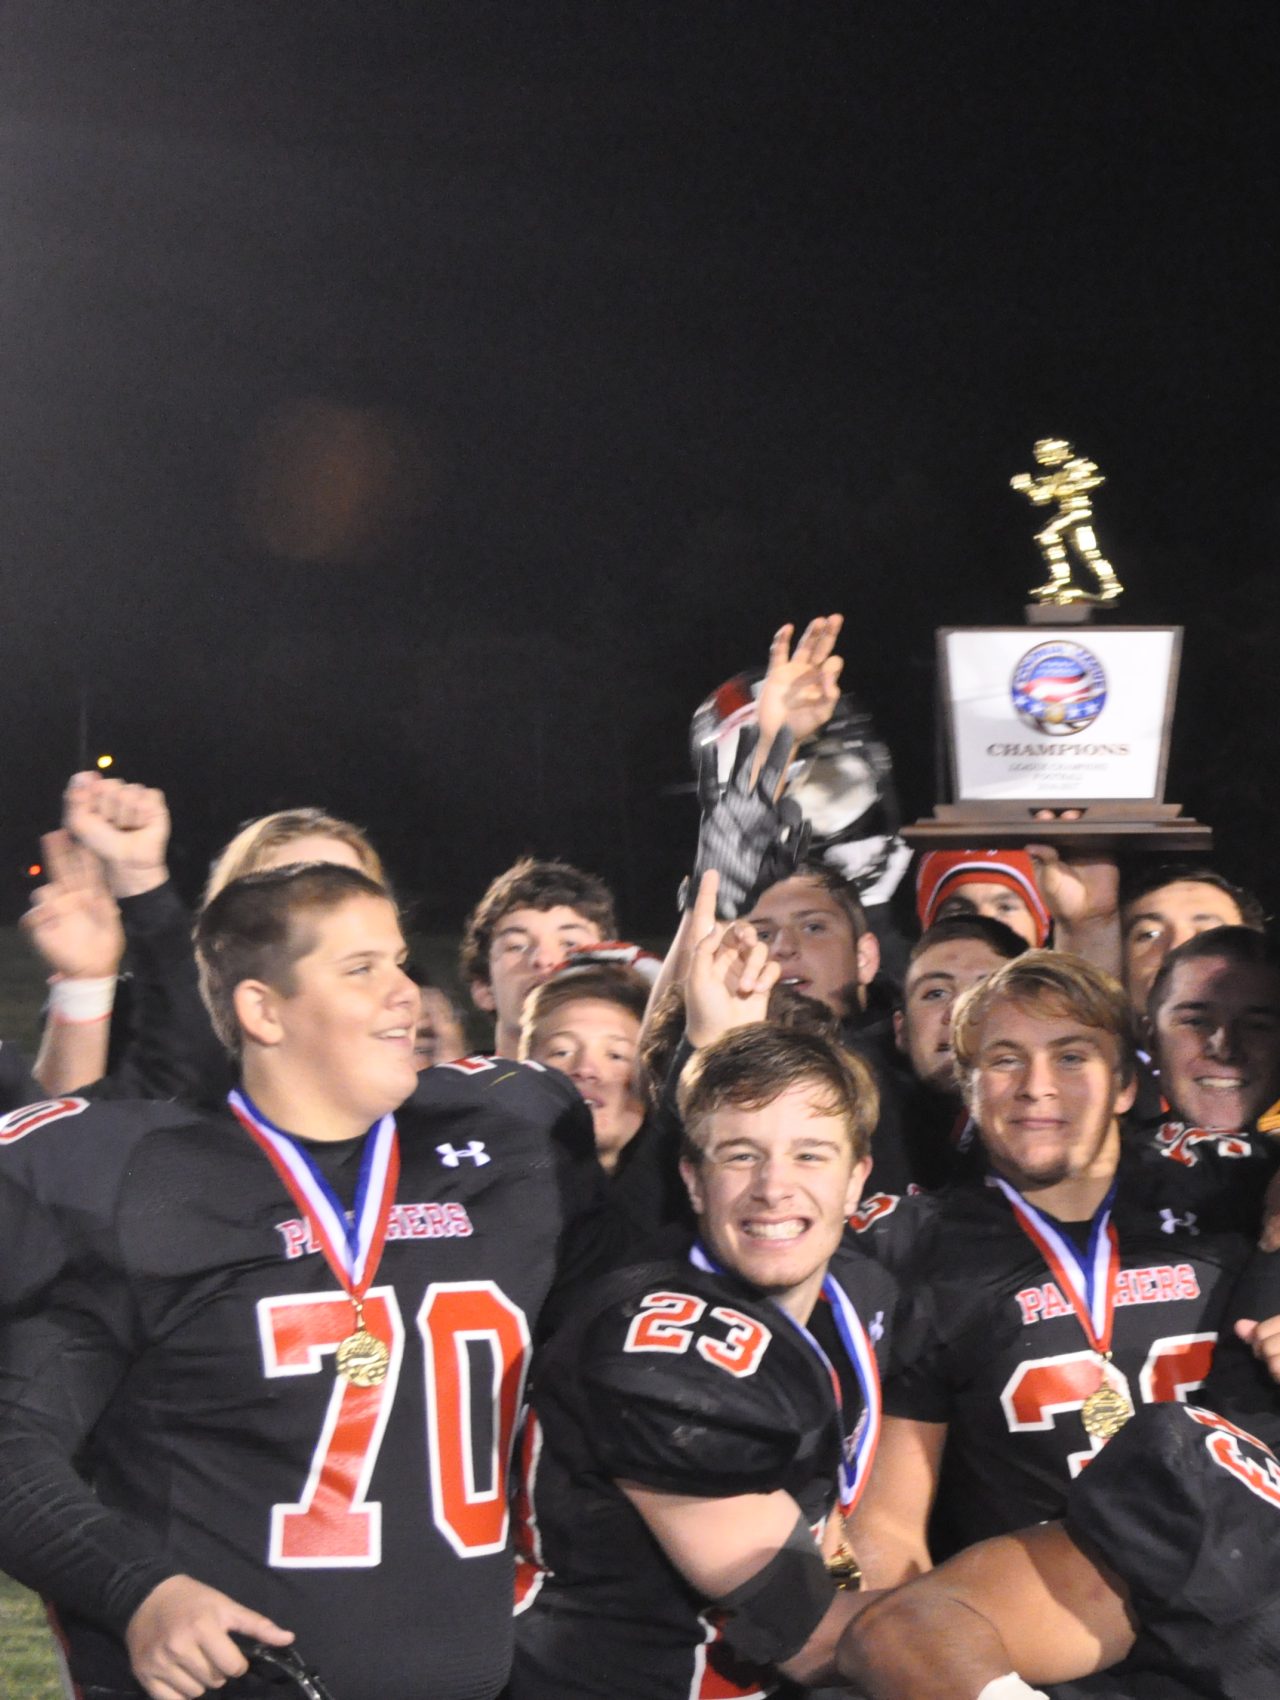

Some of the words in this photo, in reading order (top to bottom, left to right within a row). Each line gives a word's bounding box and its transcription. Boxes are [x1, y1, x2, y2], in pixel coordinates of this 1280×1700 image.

[986, 743, 1130, 757] CHAMPIONS
[1014, 1263, 1201, 1325] PAHERS
[623, 1291, 773, 1378] 23
[257, 1280, 531, 1568] 70
